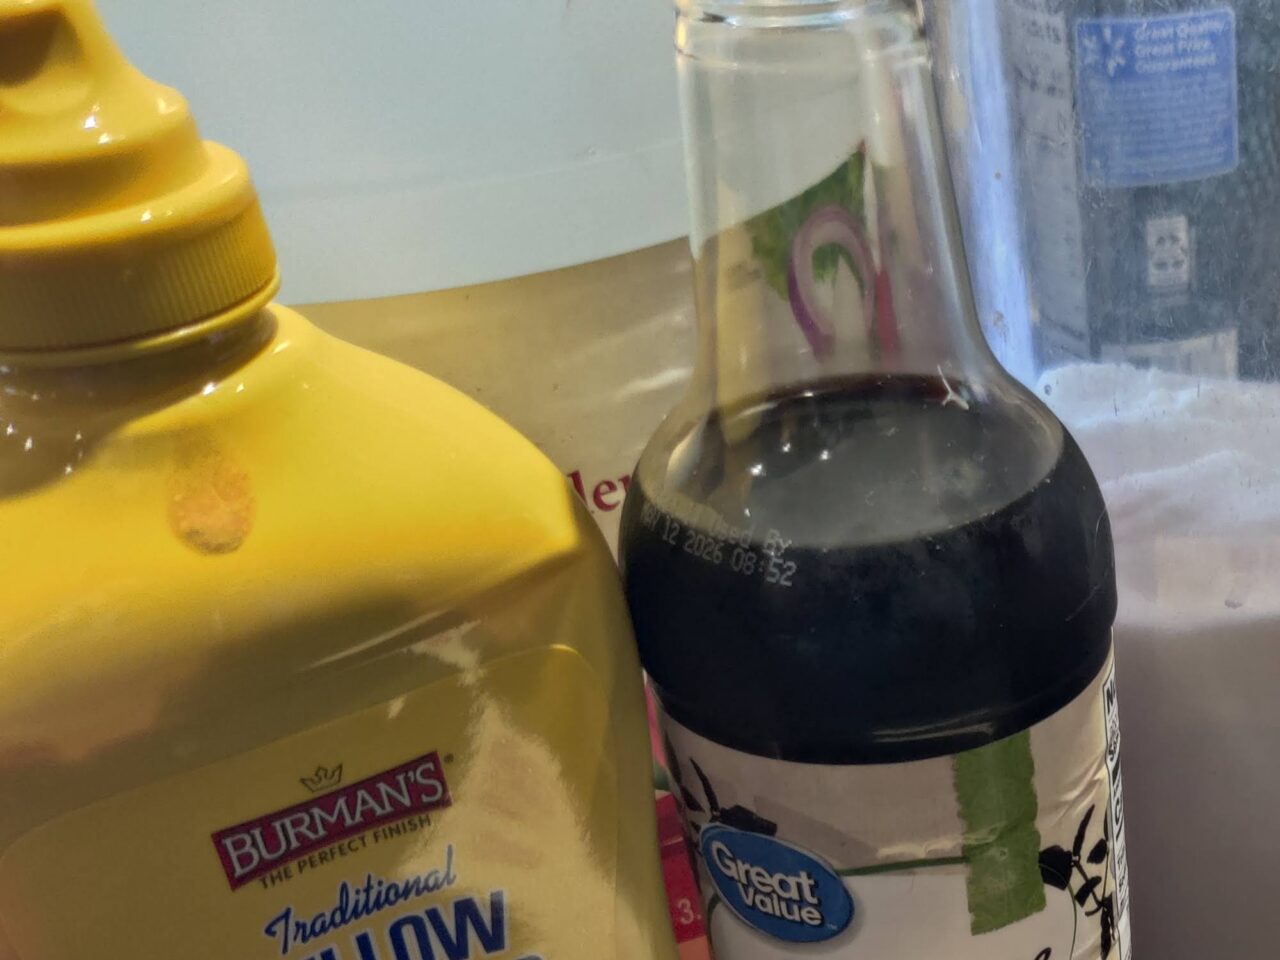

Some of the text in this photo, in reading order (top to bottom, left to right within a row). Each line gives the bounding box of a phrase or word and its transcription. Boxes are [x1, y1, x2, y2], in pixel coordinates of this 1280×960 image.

[683, 529, 723, 564] 2026
[222, 760, 445, 878] BURMAN'S
[260, 813, 432, 889] THE PERFECT FINISH
[264, 844, 457, 955] Traditional
[711, 840, 818, 906] Great
[738, 884, 823, 928] Value
